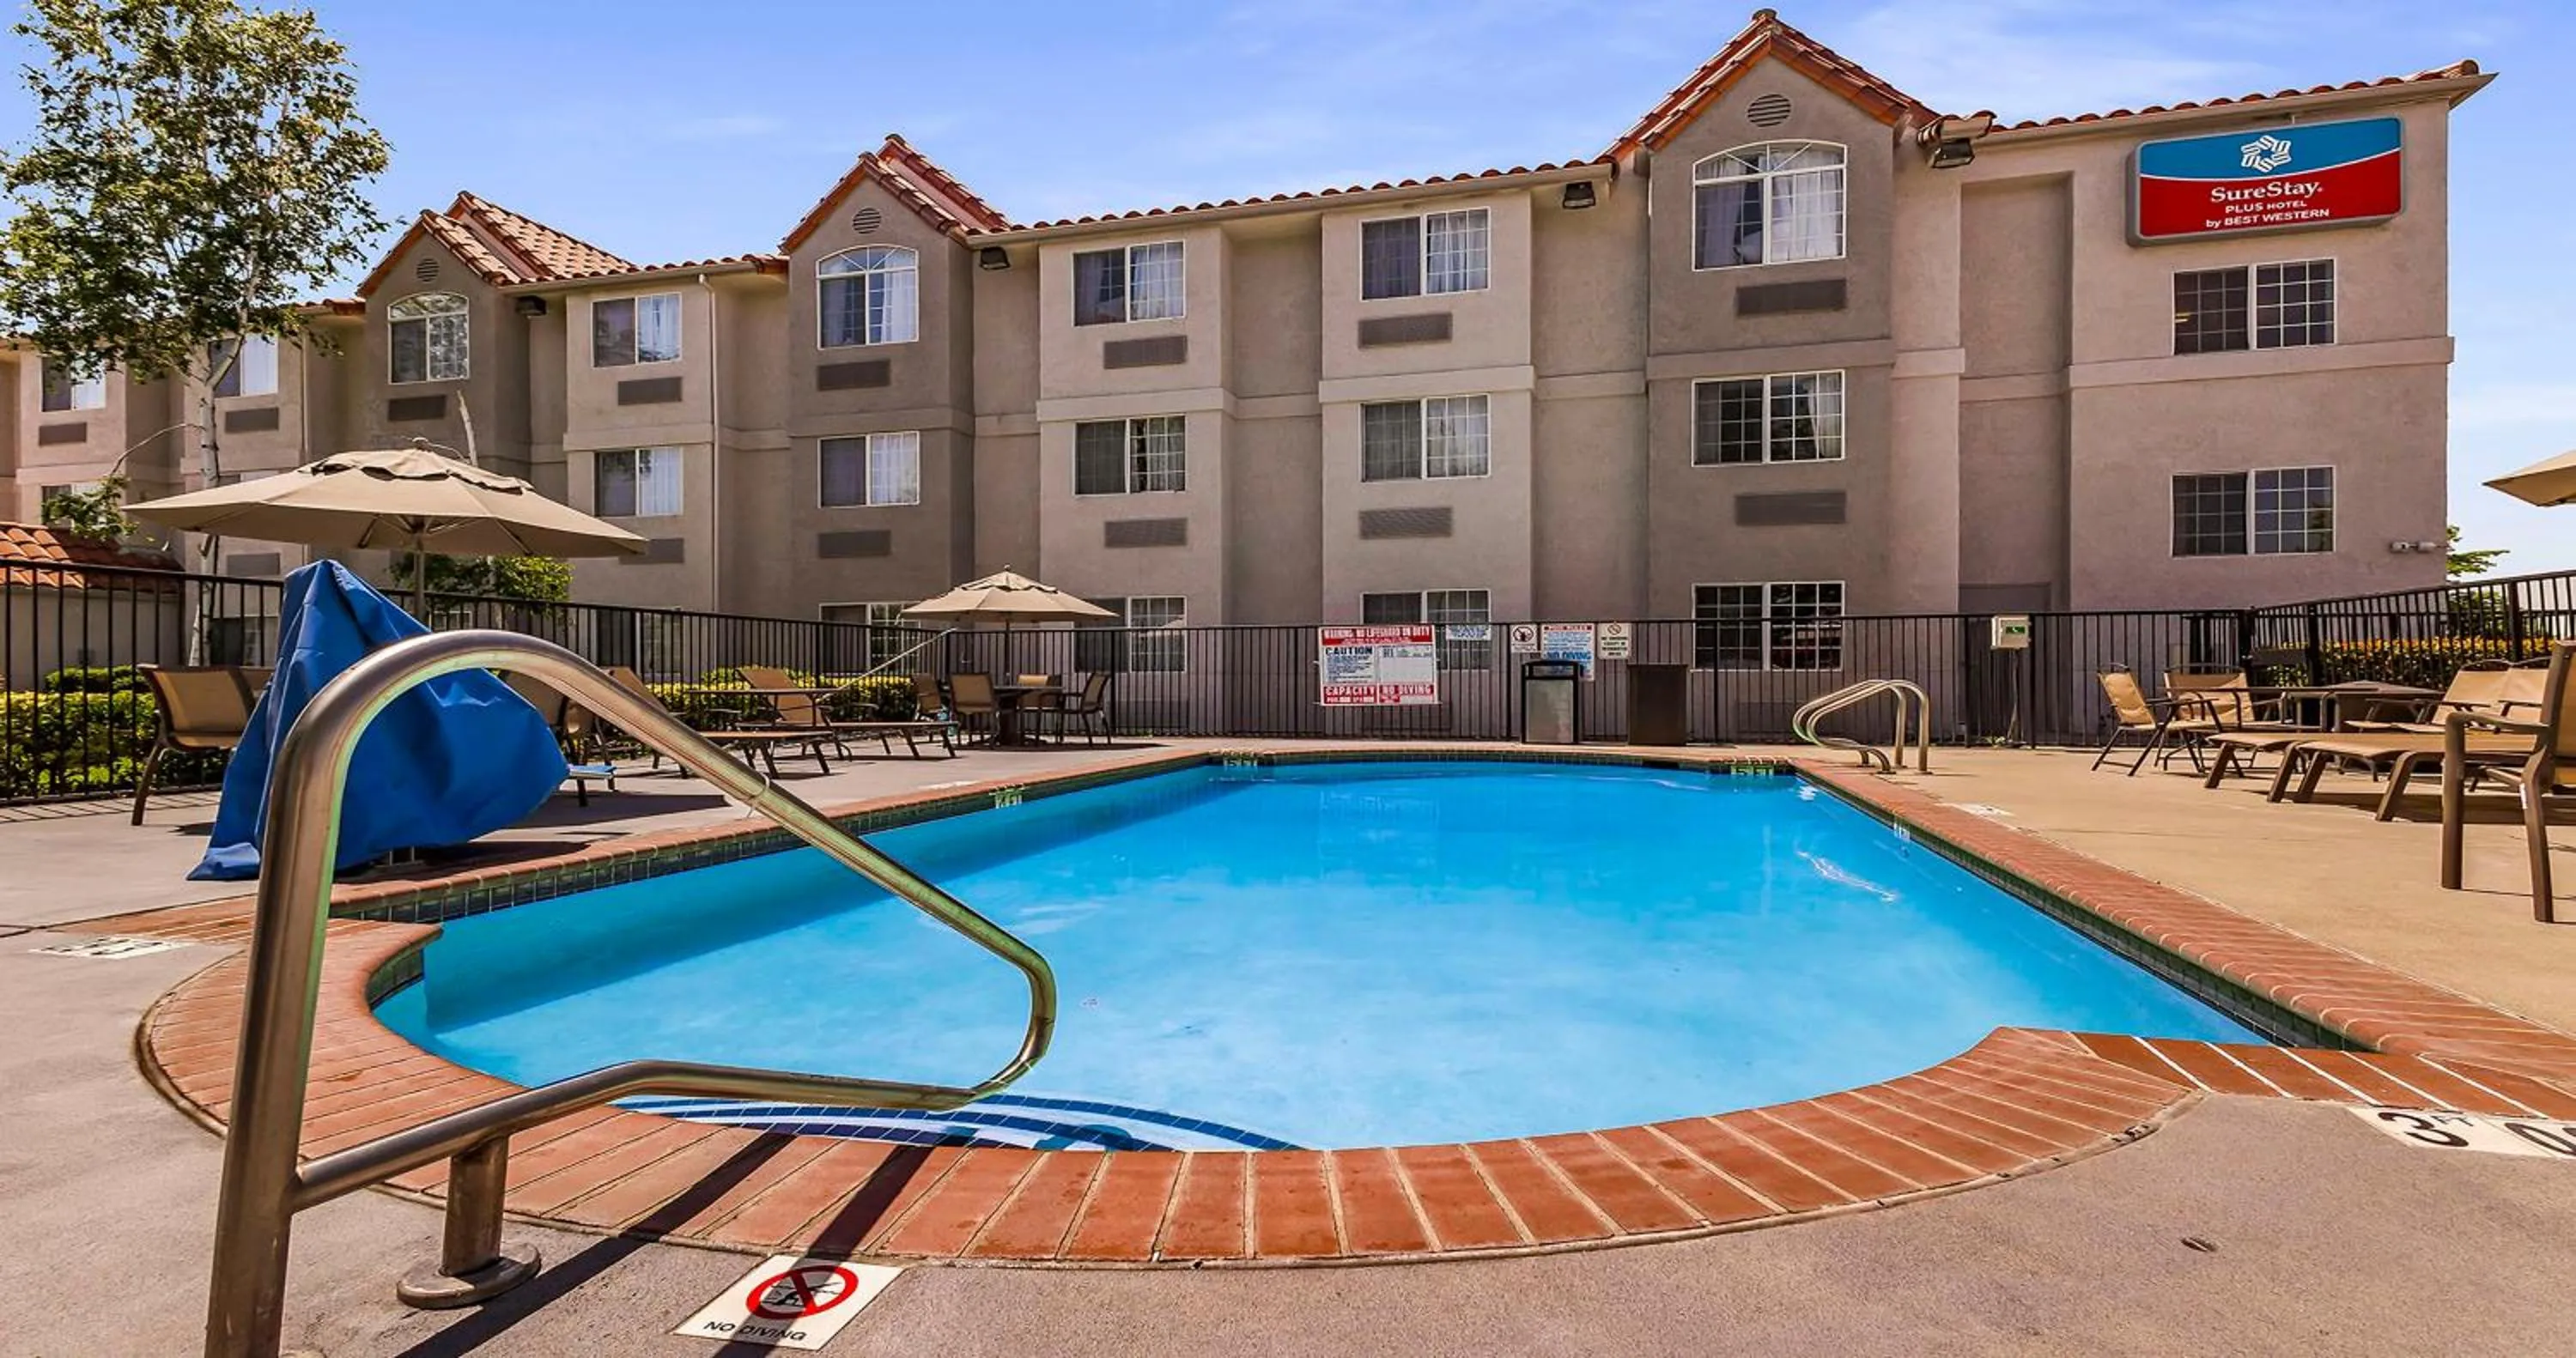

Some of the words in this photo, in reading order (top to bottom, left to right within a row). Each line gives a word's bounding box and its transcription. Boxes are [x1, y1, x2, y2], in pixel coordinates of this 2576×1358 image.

[2210, 181, 2320, 203] SureStay
[2225, 202, 2263, 214] PLUS
[2267, 200, 2307, 210] HOTEL
[2206, 219, 2221, 228] by
[2224, 215, 2258, 226] BEST
[2263, 209, 2330, 222] WESTERN
[1325, 646, 1372, 655] CAUTION
[1326, 686, 1374, 695] CAPACITY
[1382, 686, 1395, 694] NO
[1399, 684, 1431, 694] DIVING
[2378, 1112, 2469, 1147] 3
[703, 1322, 736, 1331] NO
[738, 1325, 807, 1341] DIVING
